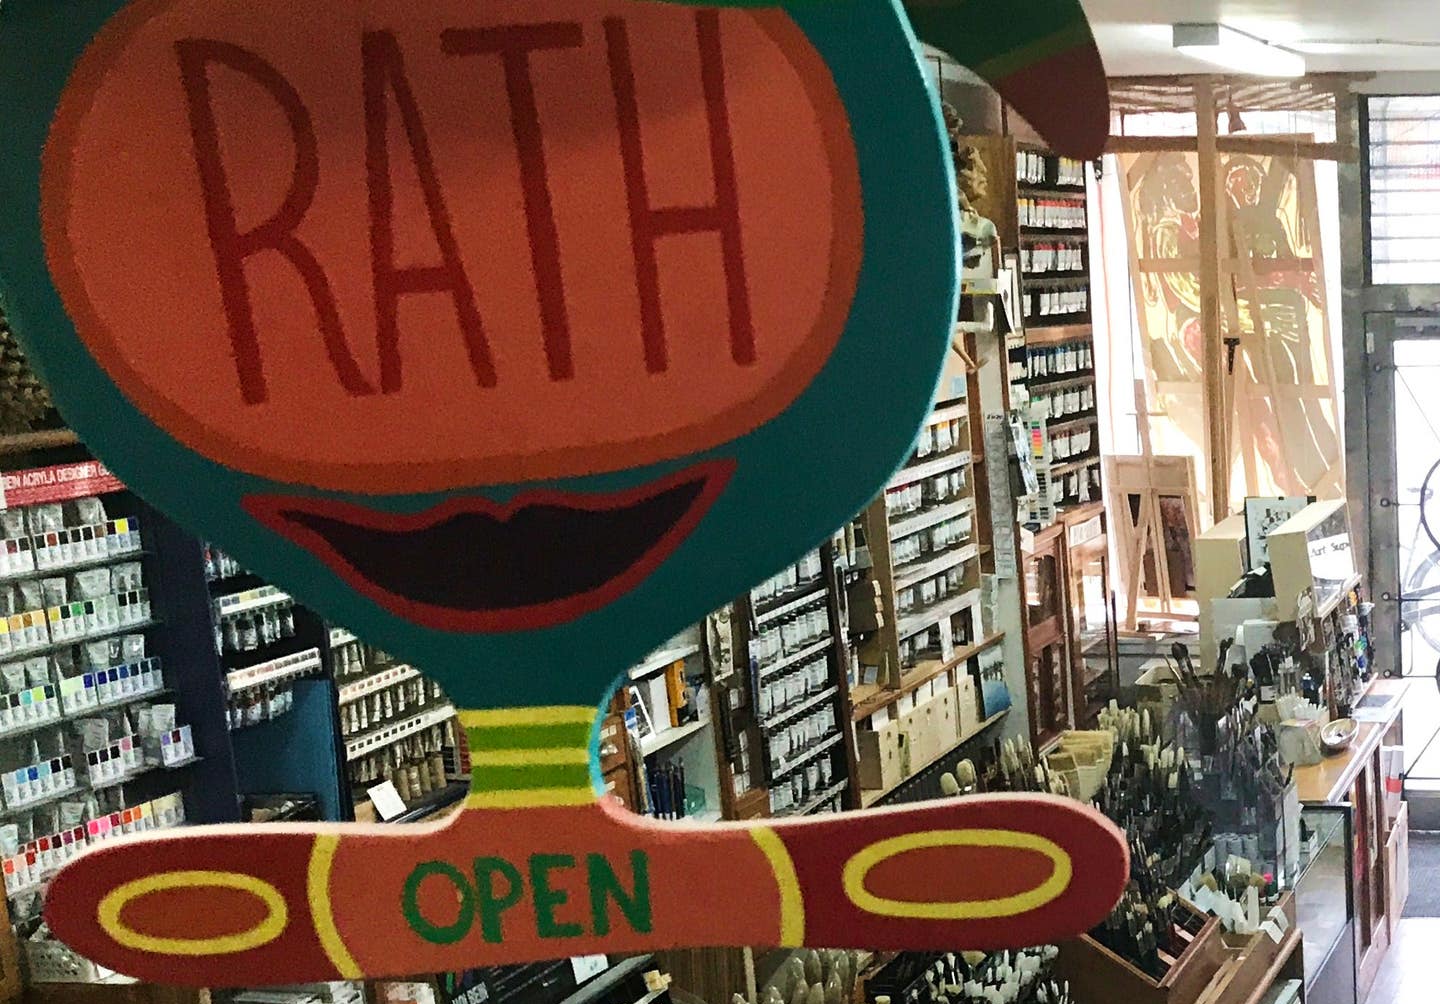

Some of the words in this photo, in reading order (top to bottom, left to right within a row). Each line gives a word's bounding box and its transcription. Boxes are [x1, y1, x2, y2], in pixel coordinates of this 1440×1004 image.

[172, 8, 756, 405] RATH
[57, 464, 97, 482] DESIGNER
[401, 850, 653, 945] OPEN
